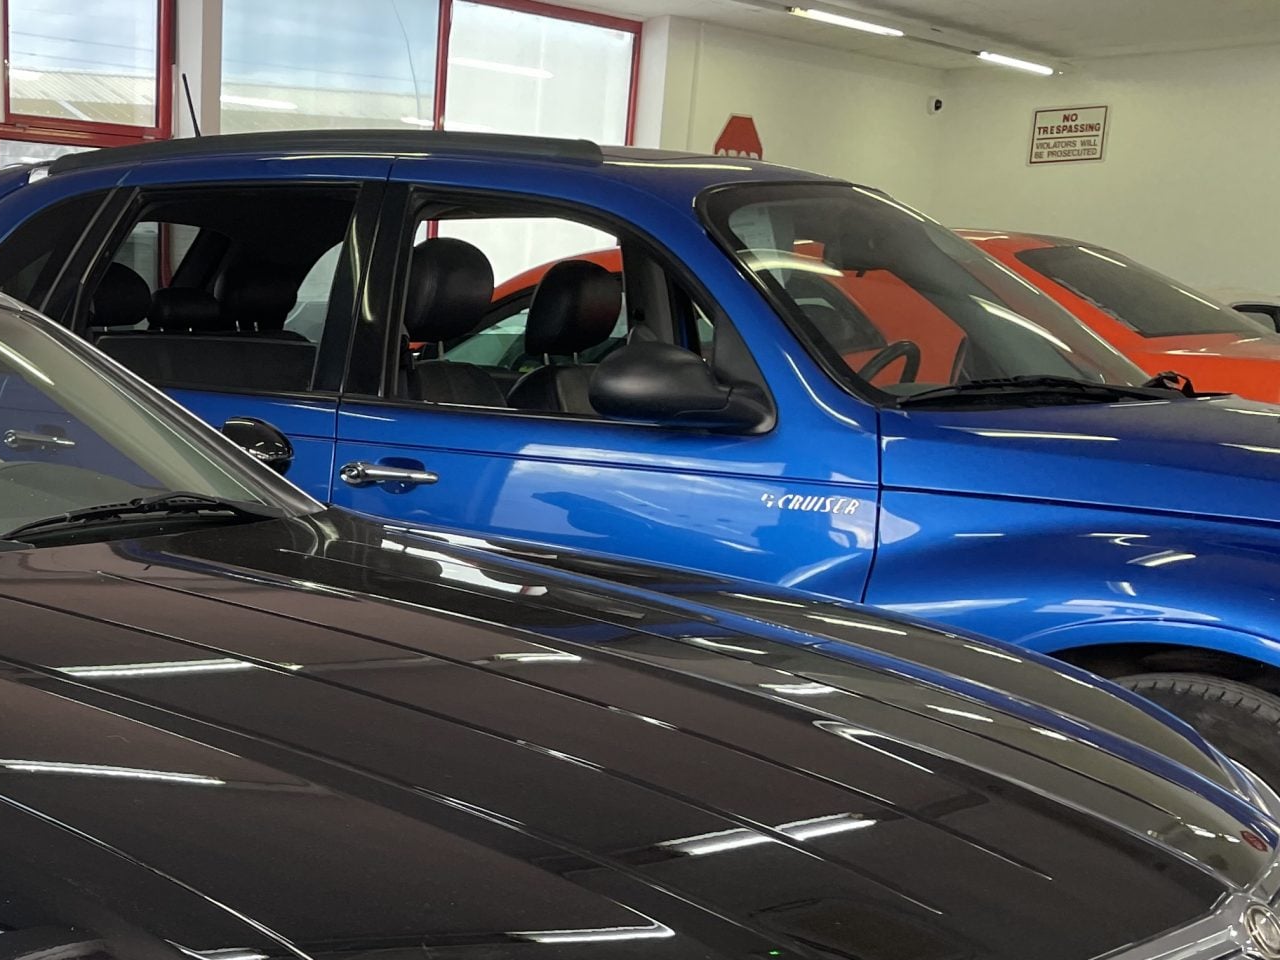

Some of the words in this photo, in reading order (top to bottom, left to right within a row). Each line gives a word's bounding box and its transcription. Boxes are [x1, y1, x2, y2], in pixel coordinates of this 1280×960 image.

[1062, 113, 1078, 123] NO
[1037, 122, 1101, 135] TRESPASSING
[1035, 140, 1077, 150] VIOLATORS
[1080, 139, 1098, 147] WILL
[1034, 151, 1044, 159] BE
[1047, 148, 1097, 158] PROSECUTED
[777, 494, 859, 514] CRUISER
